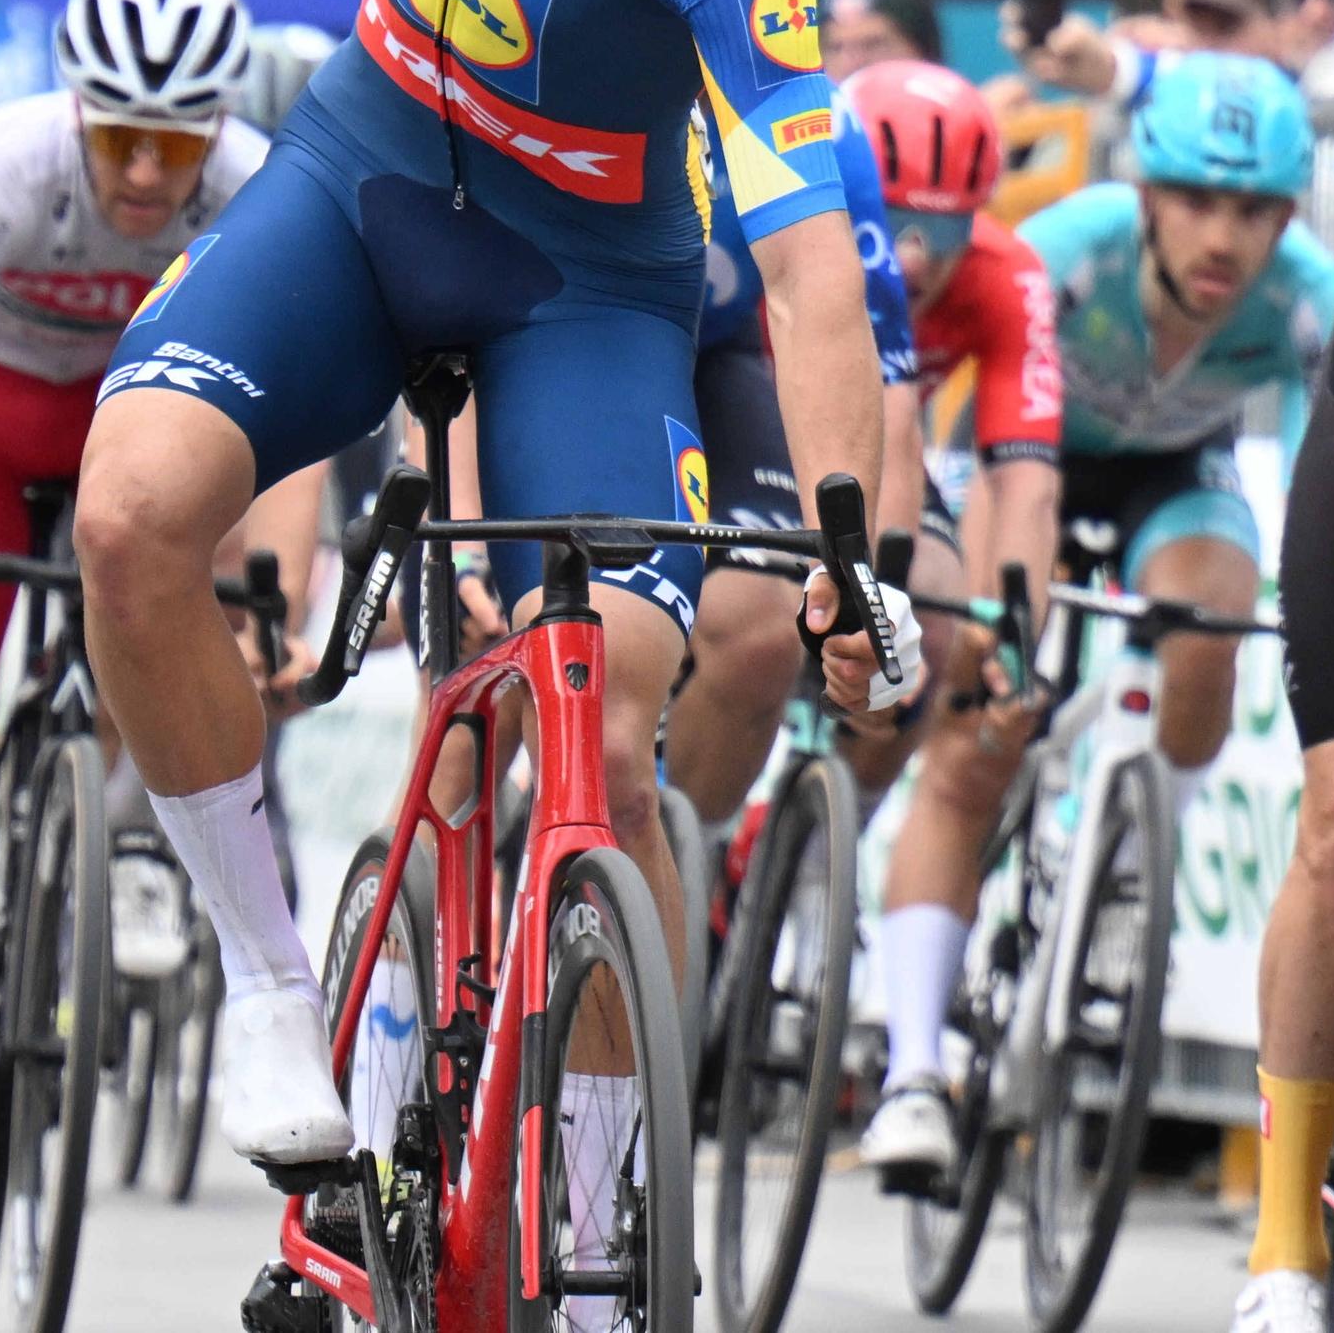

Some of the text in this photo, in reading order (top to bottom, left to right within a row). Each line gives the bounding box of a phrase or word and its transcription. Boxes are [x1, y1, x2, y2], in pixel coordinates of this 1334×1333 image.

[781, 112, 832, 145] PIRE
[153, 341, 267, 400] Santini
[348, 550, 395, 651] SRAM
[853, 562, 897, 659] SRAM
[305, 1257, 341, 1289] SRAM
